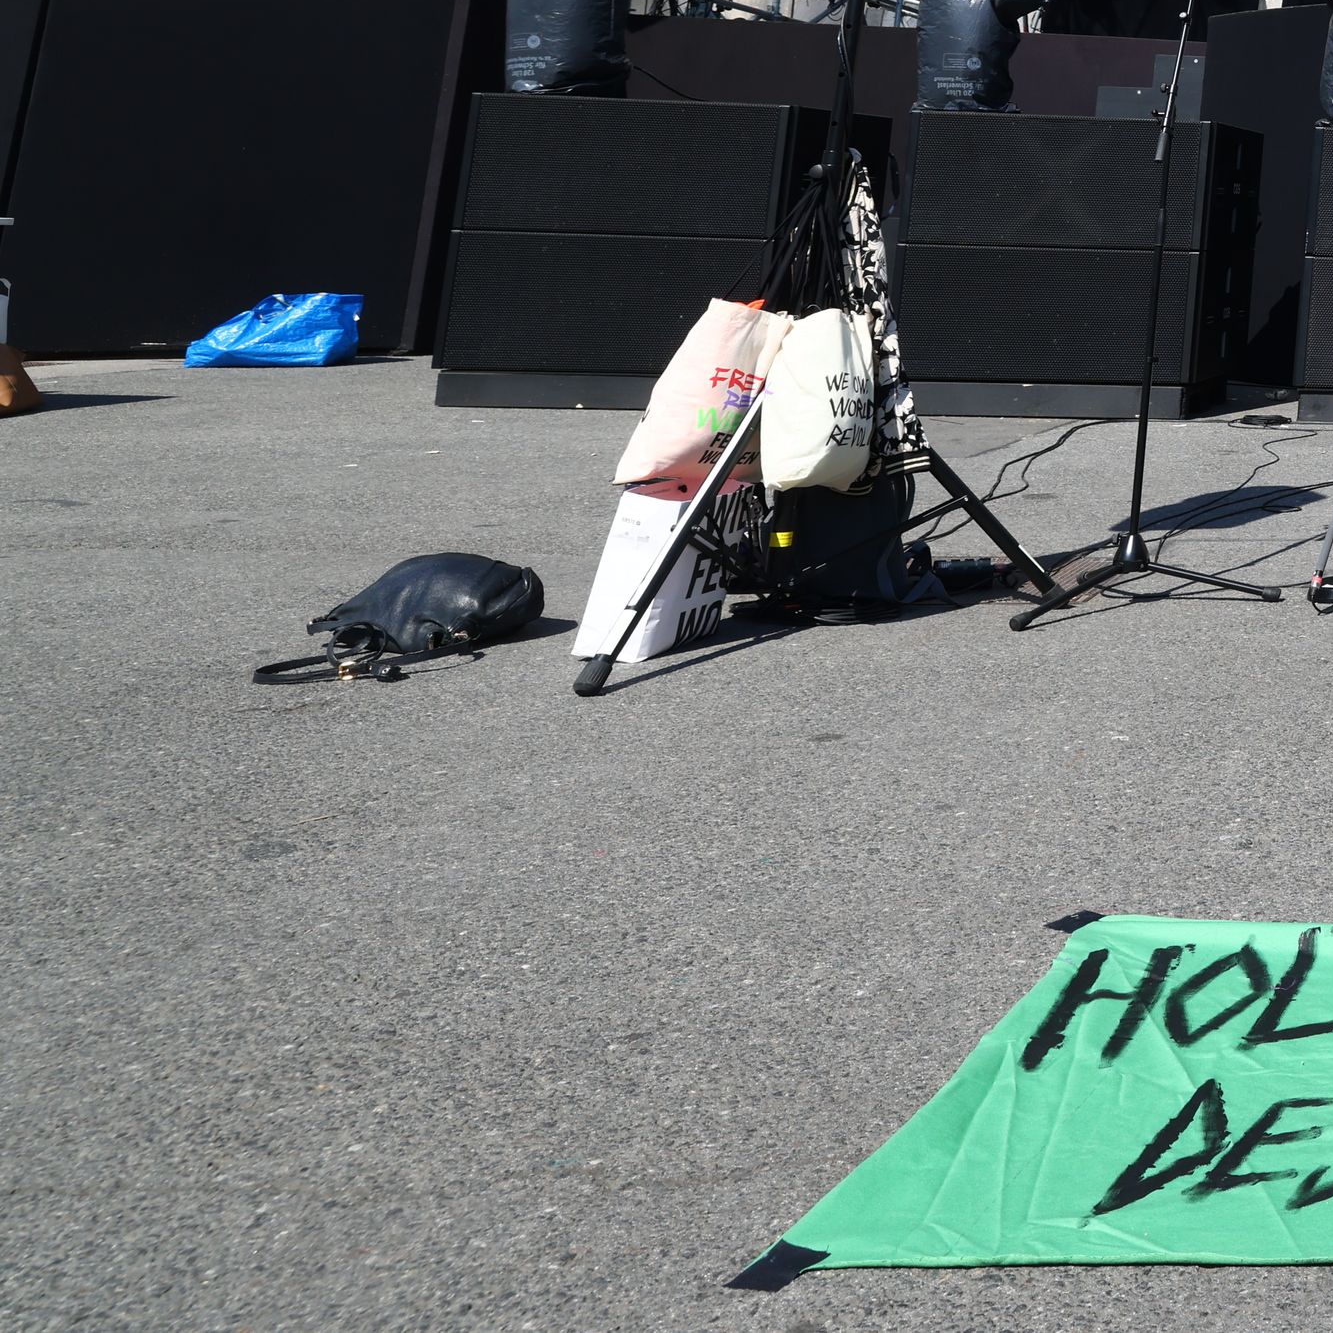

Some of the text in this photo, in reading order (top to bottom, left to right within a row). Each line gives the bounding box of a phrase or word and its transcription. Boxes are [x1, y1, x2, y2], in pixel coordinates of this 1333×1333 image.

[709, 367, 766, 394] FRE
[825, 372, 850, 392] WE
[829, 397, 875, 421] WORLD
